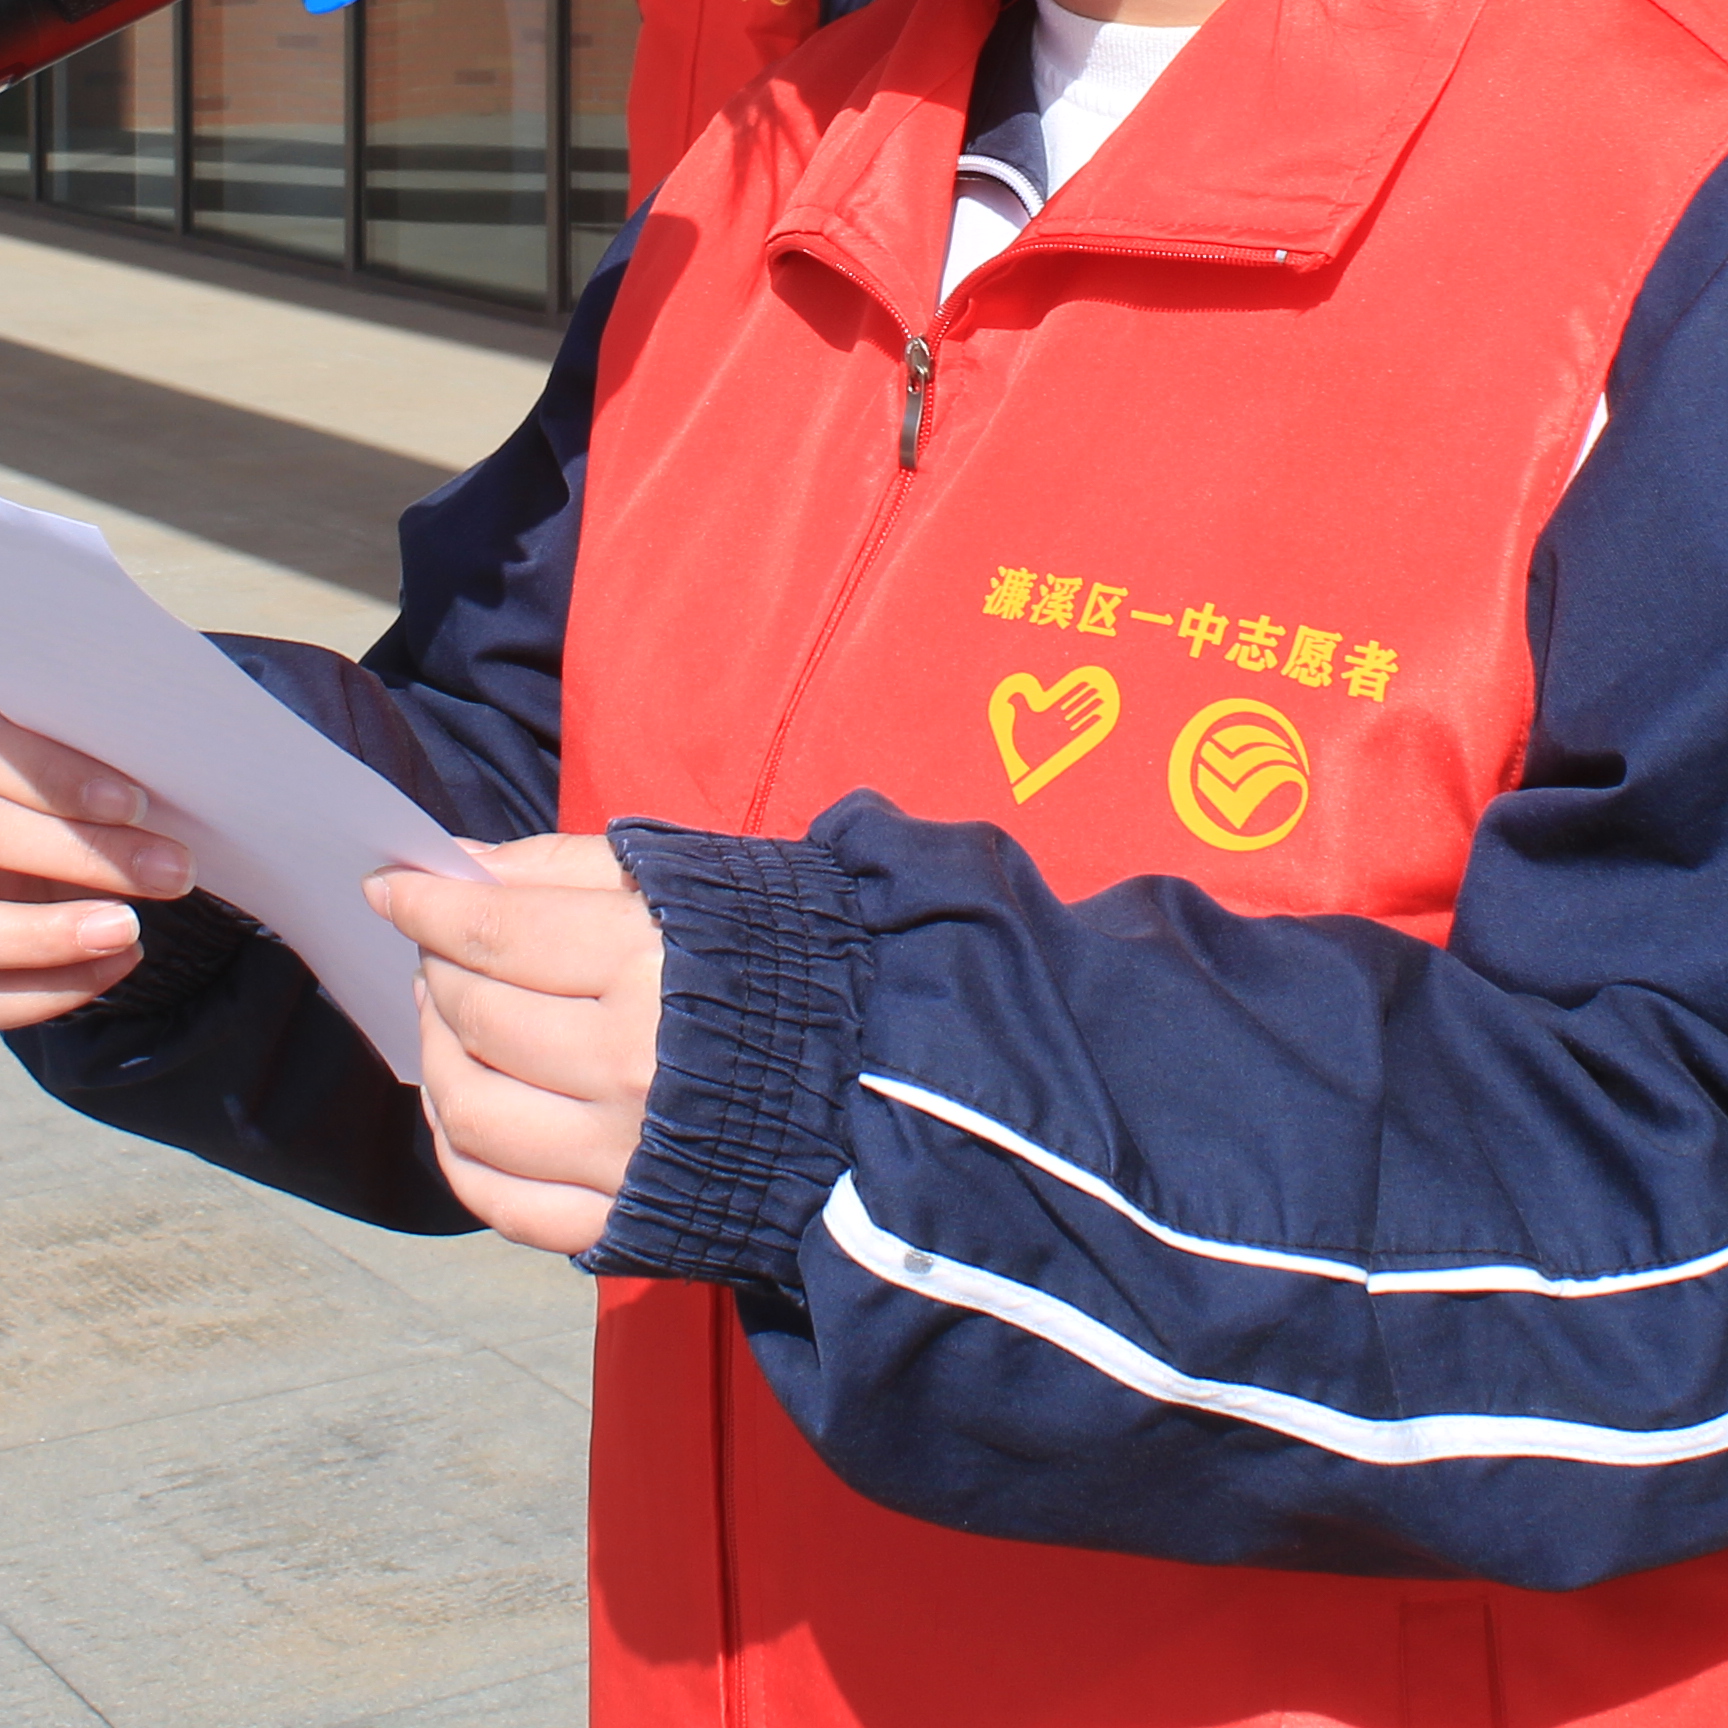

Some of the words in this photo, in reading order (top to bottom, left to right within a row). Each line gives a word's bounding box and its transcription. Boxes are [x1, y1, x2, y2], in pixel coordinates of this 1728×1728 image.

[981, 565, 1400, 703] 濂溪区一中志愿者
